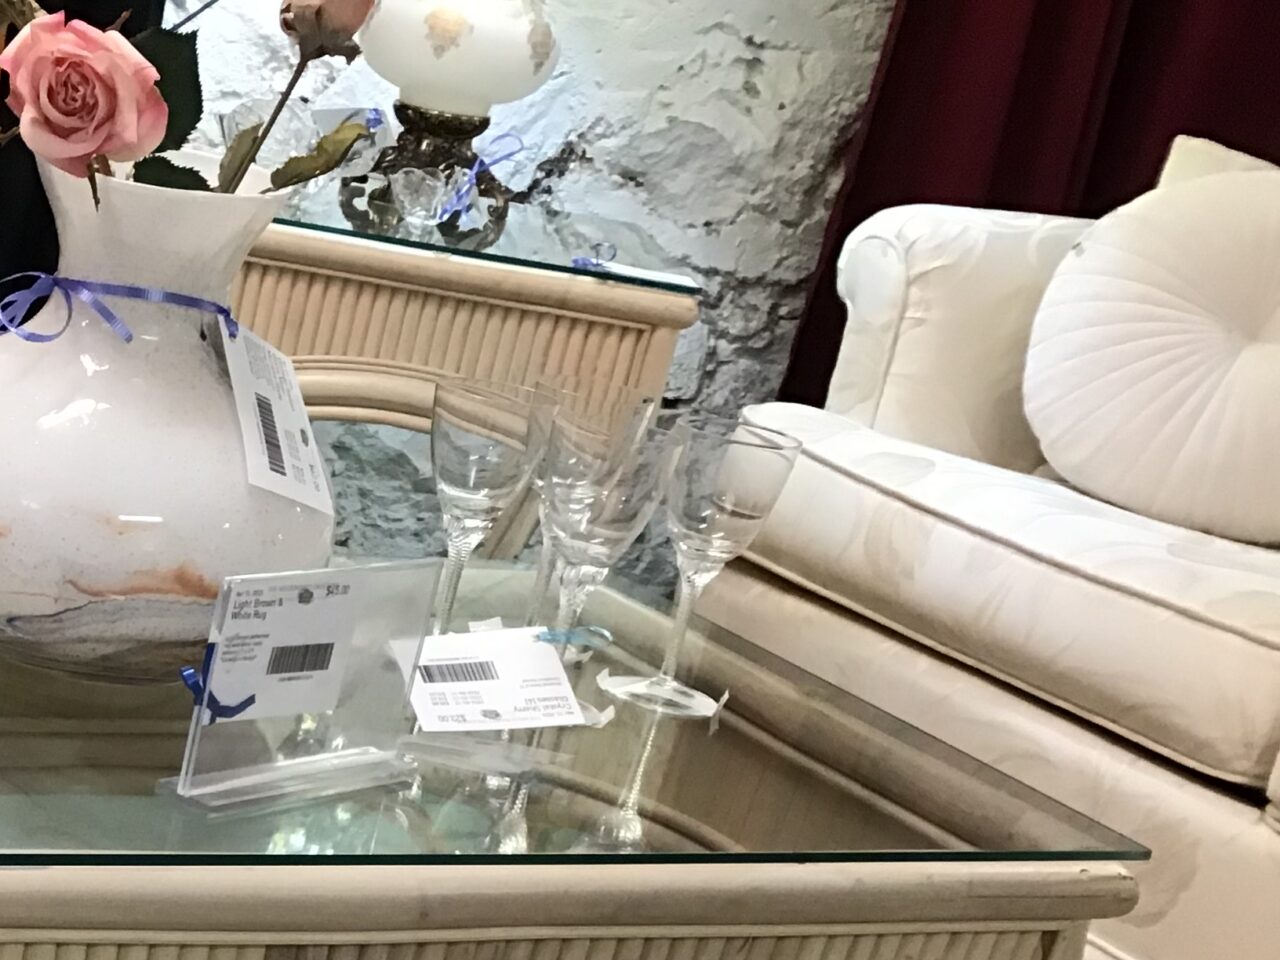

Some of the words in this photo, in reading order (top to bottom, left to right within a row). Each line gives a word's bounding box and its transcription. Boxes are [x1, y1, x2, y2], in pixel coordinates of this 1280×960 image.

[233, 599, 252, 611] Light
[253, 598, 277, 609] Brown
[231, 609, 252, 620] White
[253, 609, 267, 621] Rug
[537, 696, 569, 704] Glasses
[543, 703, 572, 711] Crystal
